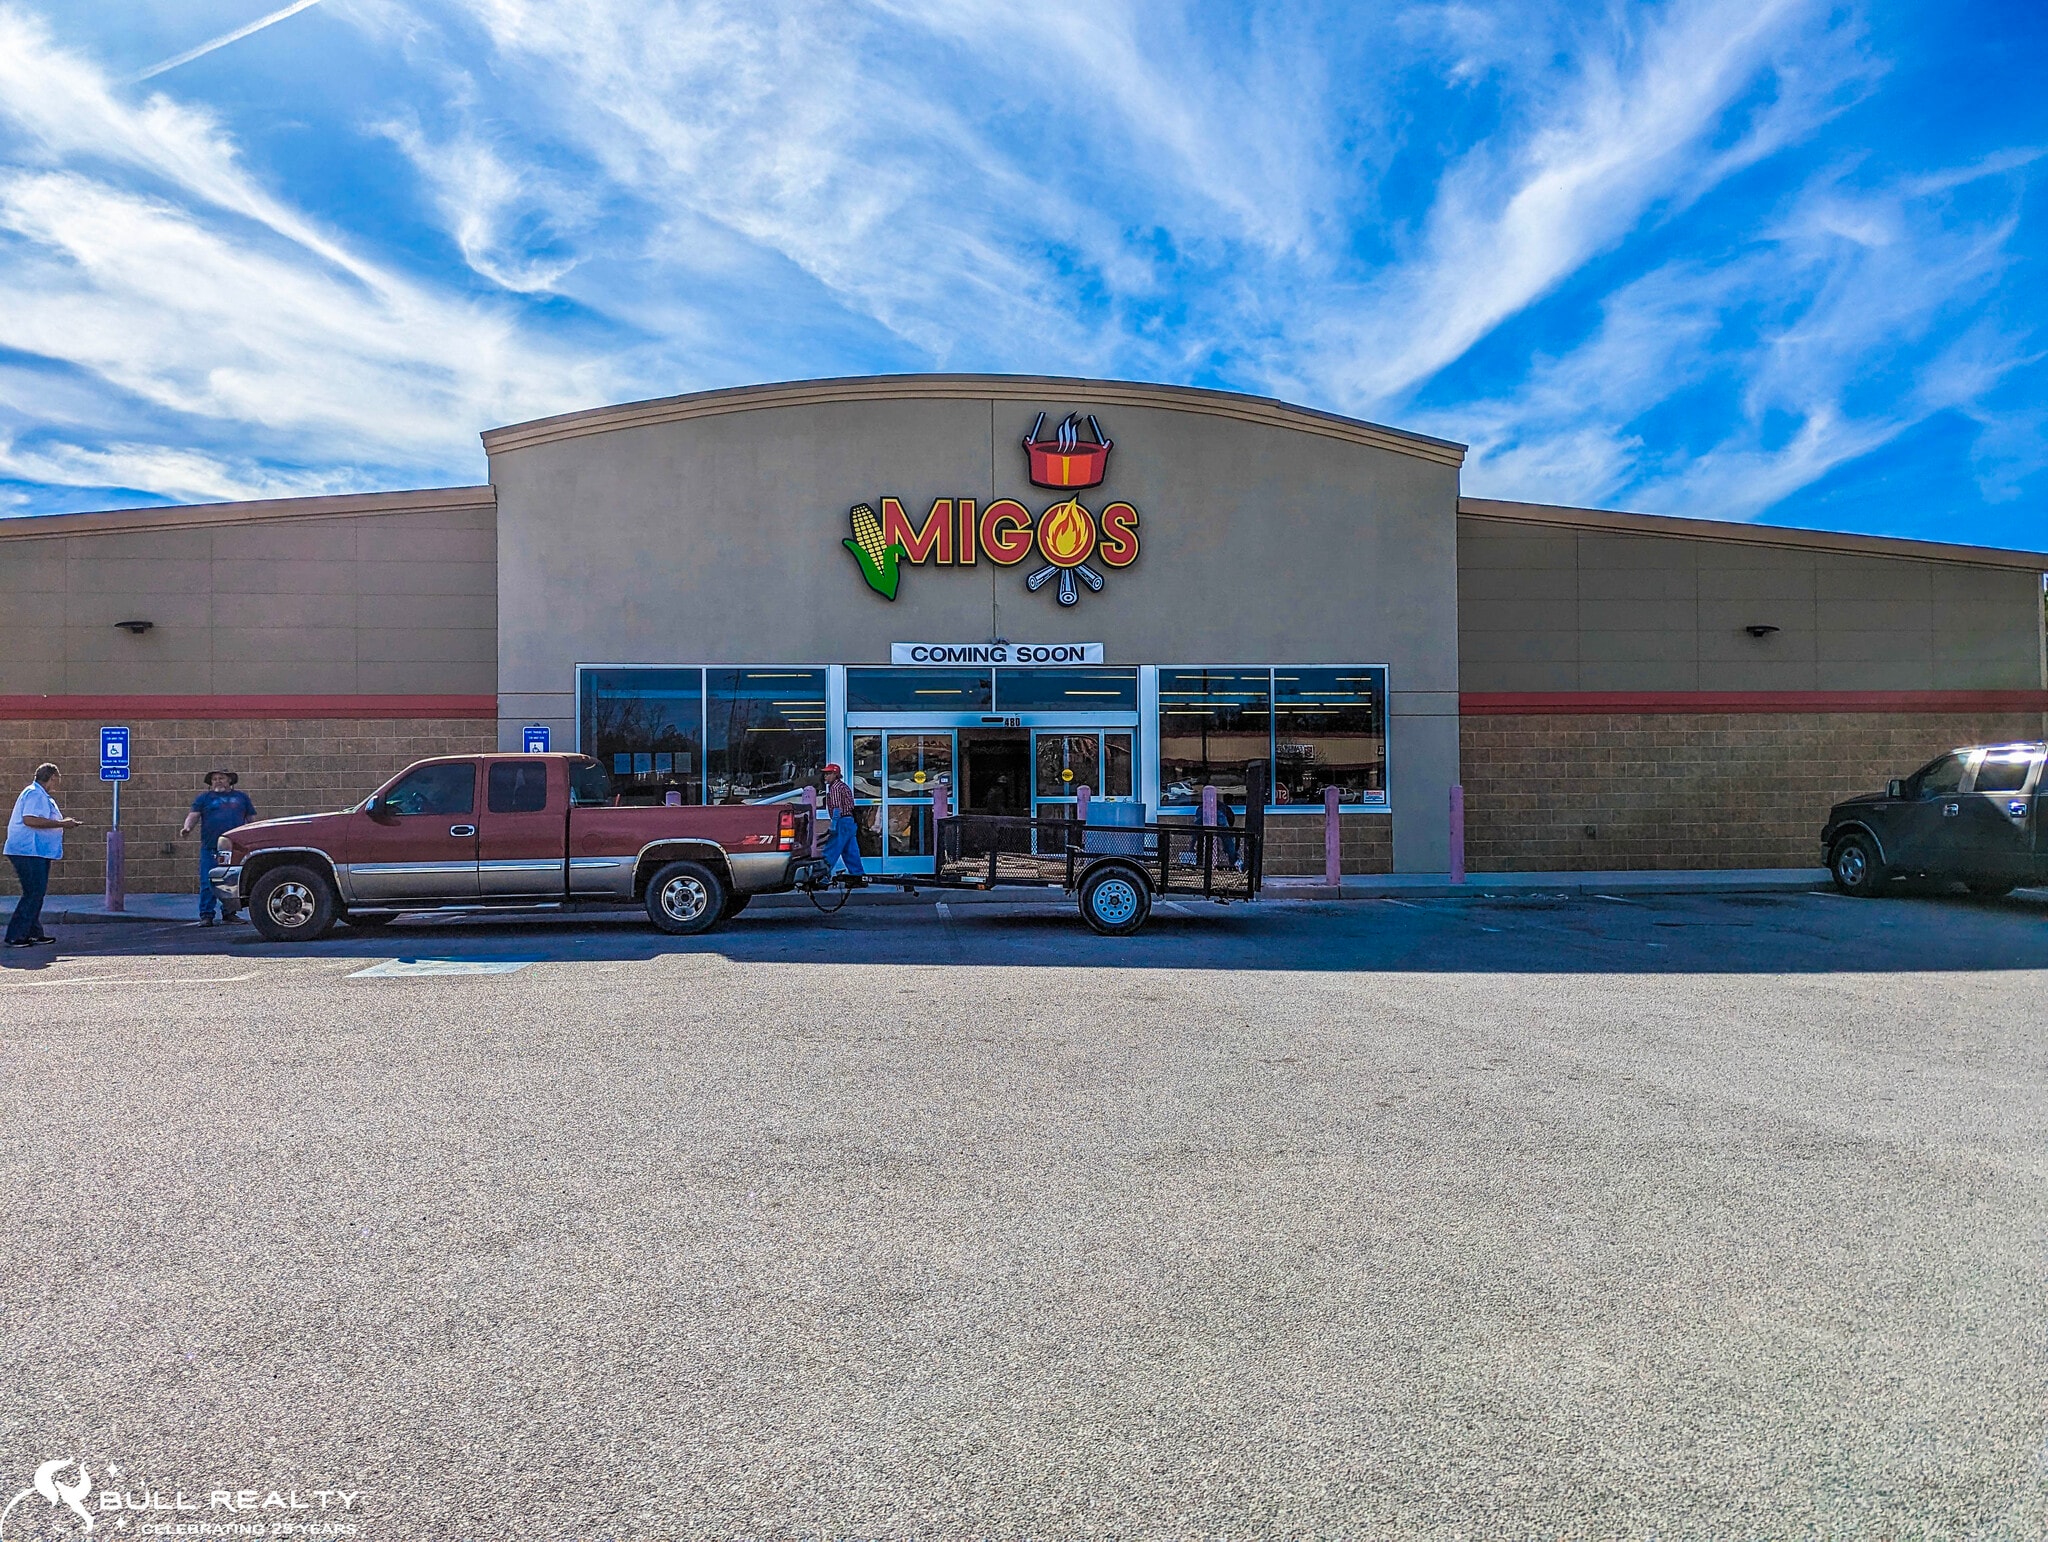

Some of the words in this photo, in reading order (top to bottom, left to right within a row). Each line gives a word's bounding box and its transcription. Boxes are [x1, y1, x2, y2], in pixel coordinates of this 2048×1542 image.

[881, 497, 1139, 567] MIGOS
[911, 646, 1007, 663] COMING
[1016, 646, 1085, 662] SOON
[1004, 717, 1020, 727] 480
[743, 834, 774, 845] Z71
